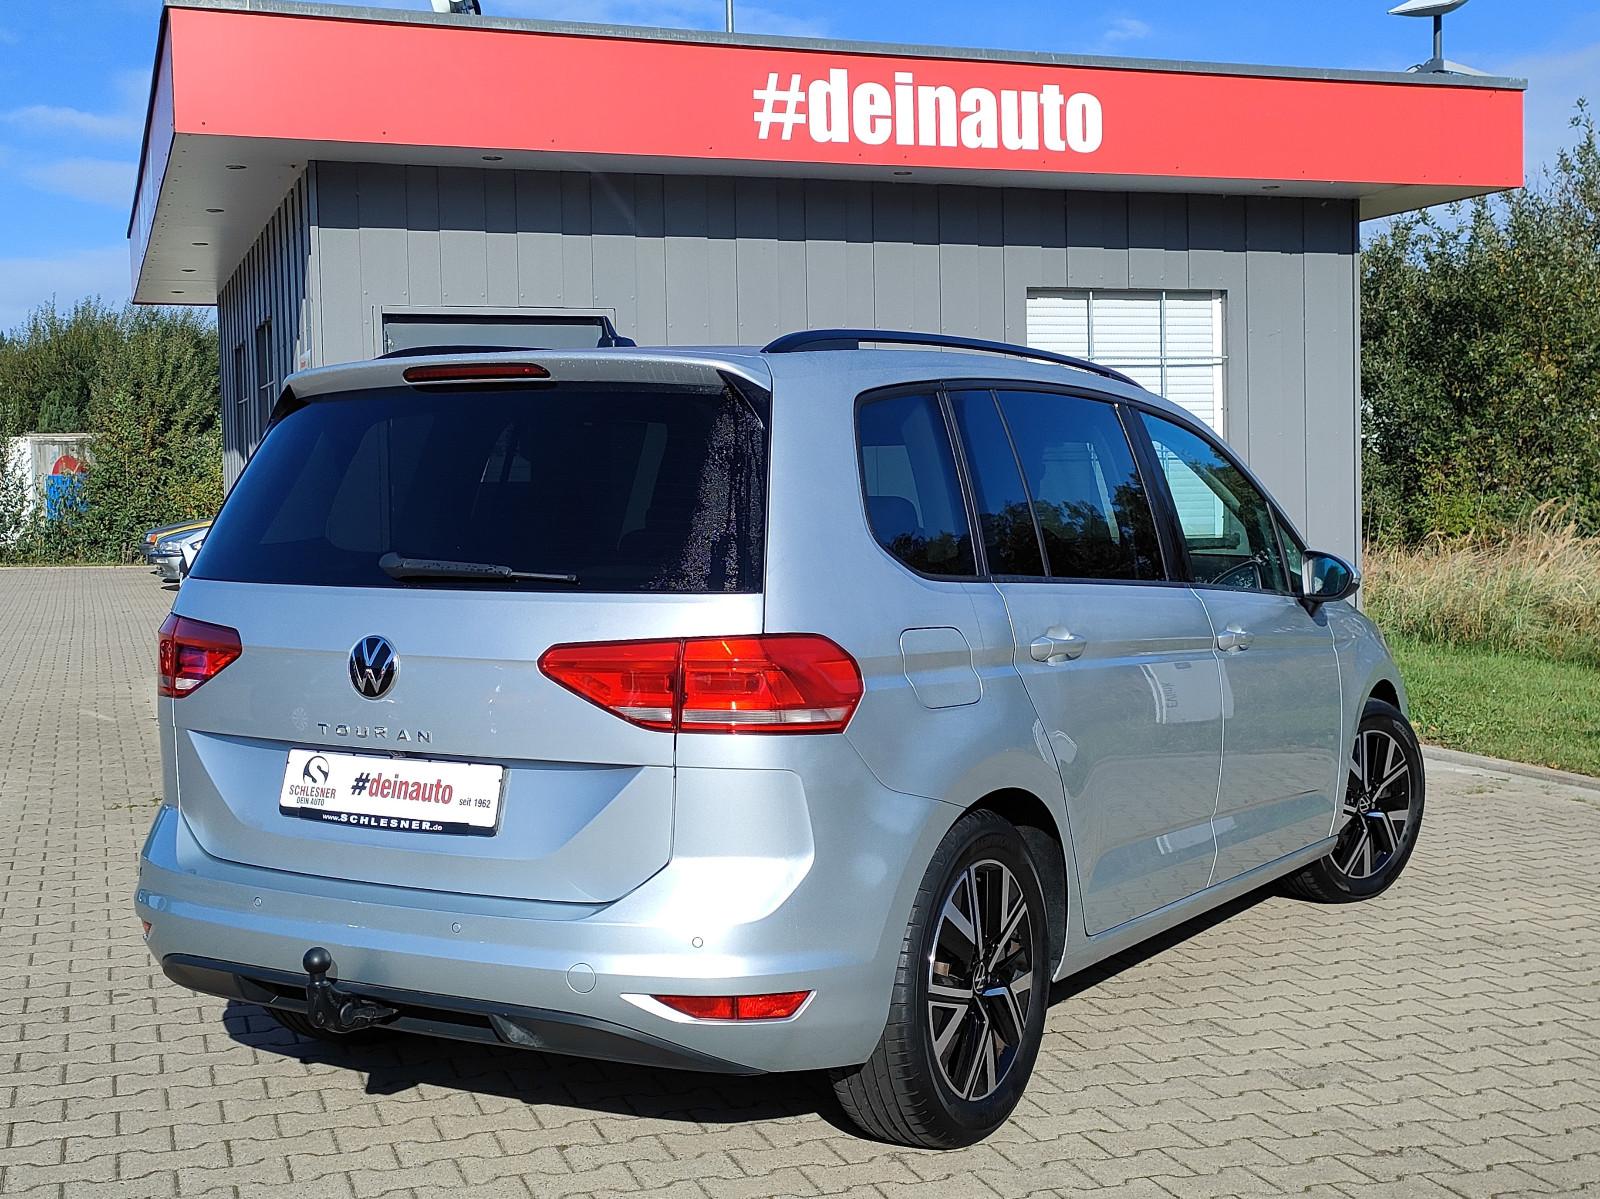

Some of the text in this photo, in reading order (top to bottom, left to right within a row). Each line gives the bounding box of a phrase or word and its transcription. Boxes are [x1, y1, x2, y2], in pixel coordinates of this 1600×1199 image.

[753, 68, 1103, 154] #deinauto
[317, 722, 433, 744] TOURAN
[289, 784, 336, 799] SCHLESNER
[351, 772, 453, 804] #deinauto
[296, 796, 325, 806] DEIN AUTO
[459, 798, 491, 809] seit 1962
